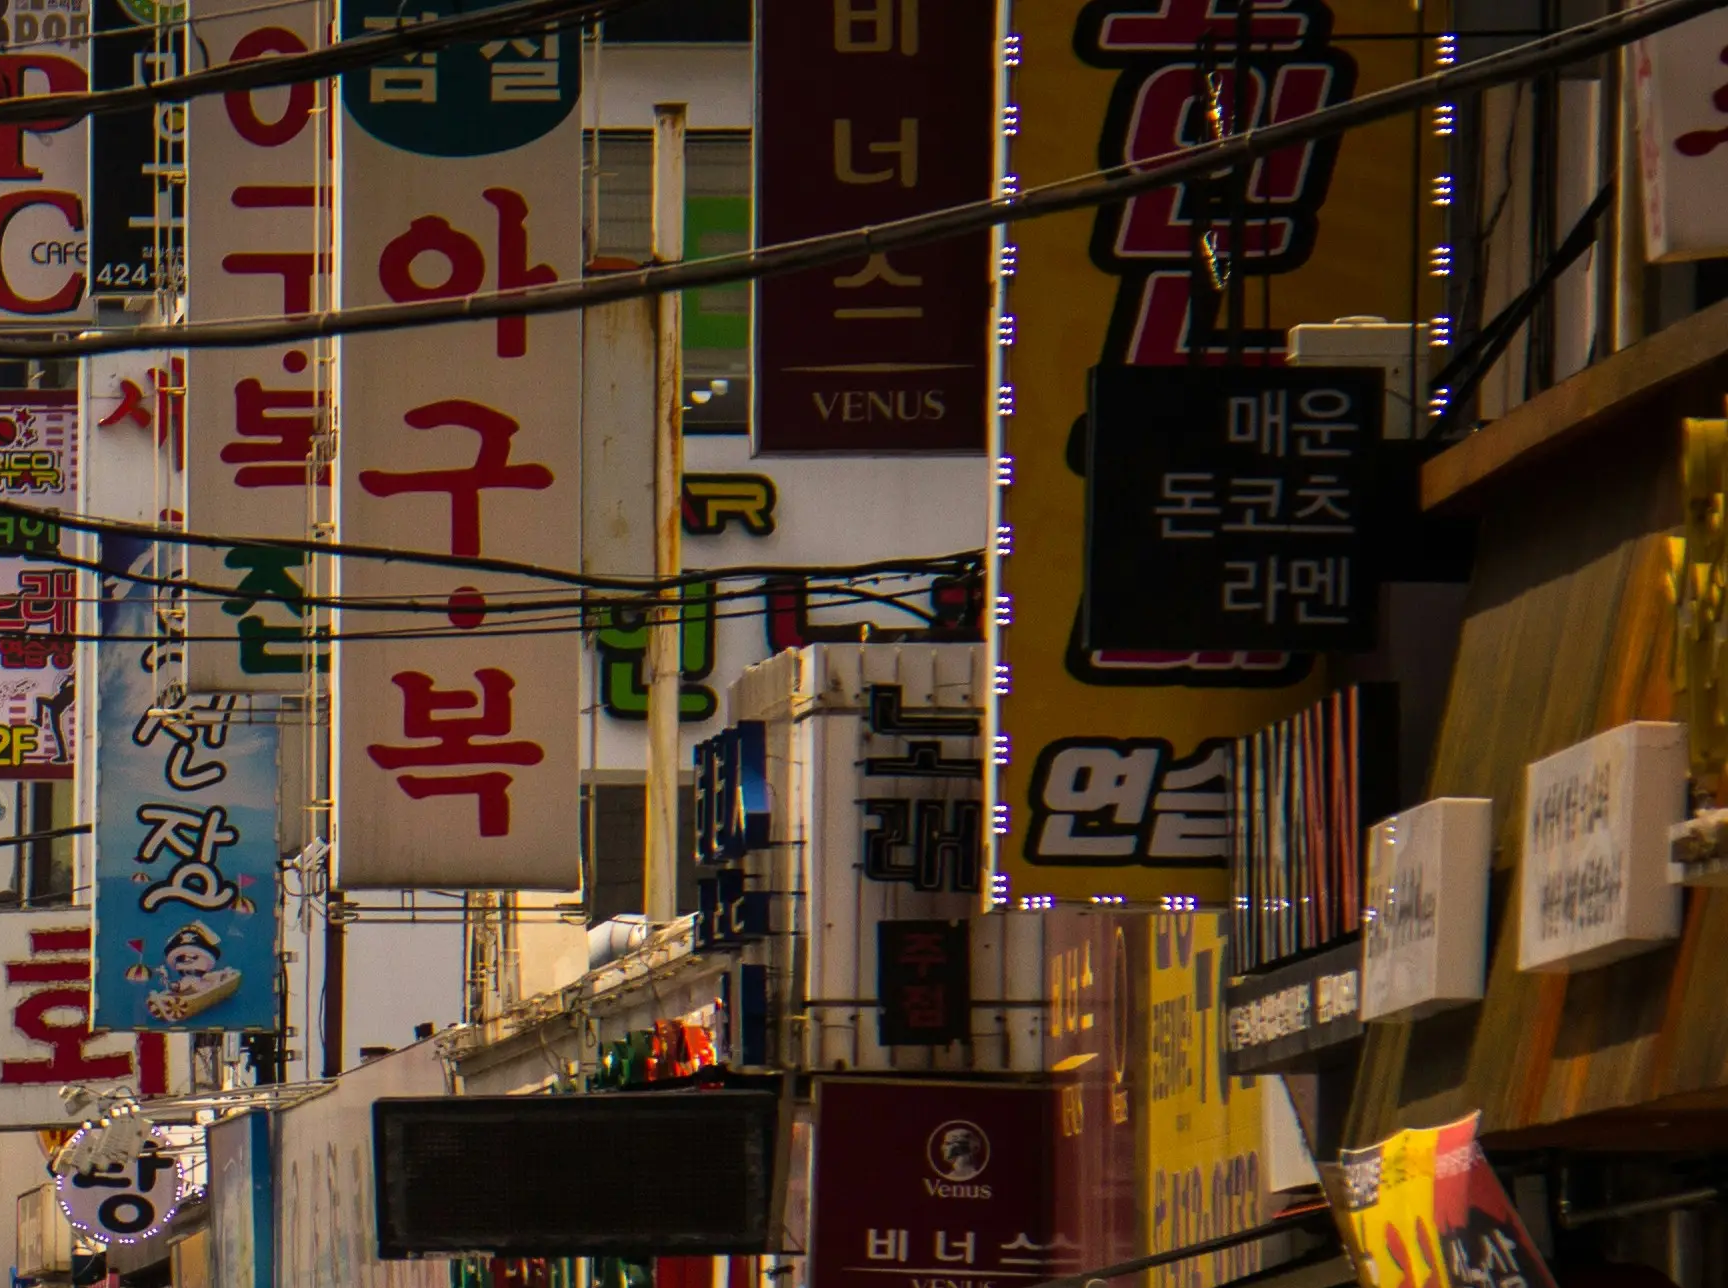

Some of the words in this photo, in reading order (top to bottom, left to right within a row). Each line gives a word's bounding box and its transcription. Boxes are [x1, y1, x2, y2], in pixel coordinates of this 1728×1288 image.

[811, 389, 947, 422] VENUS
[1227, 386, 1355, 460] 매운
[1151, 470, 1357, 541] 돈코츠
[1221, 555, 1353, 628] 라멘
[1039, 744, 1231, 859] 연습
[923, 1176, 994, 1202] Venus
[864, 1225, 1067, 1266] 비너스
